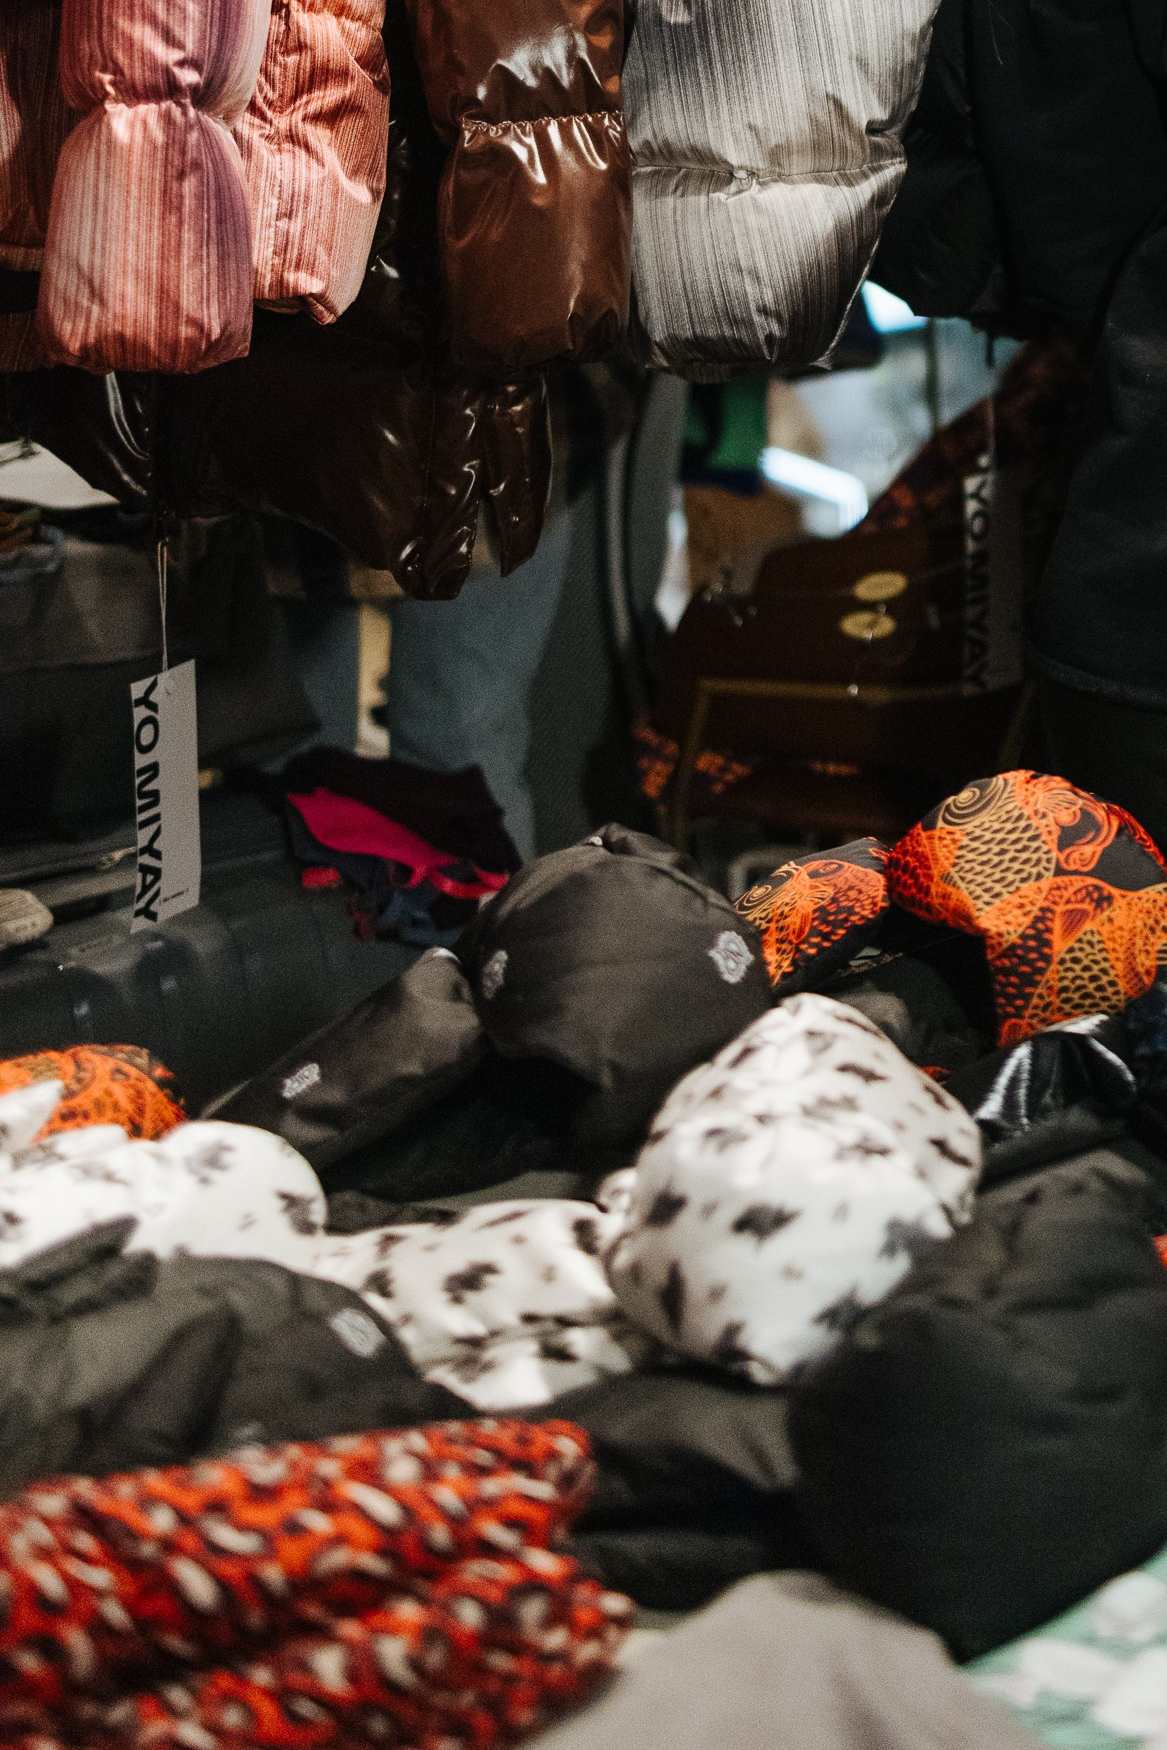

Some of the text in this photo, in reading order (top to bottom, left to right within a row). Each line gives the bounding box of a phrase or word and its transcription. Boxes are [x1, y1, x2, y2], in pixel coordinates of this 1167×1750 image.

[963, 471, 990, 541] YO
[133, 675, 163, 923] YO MIYAY
